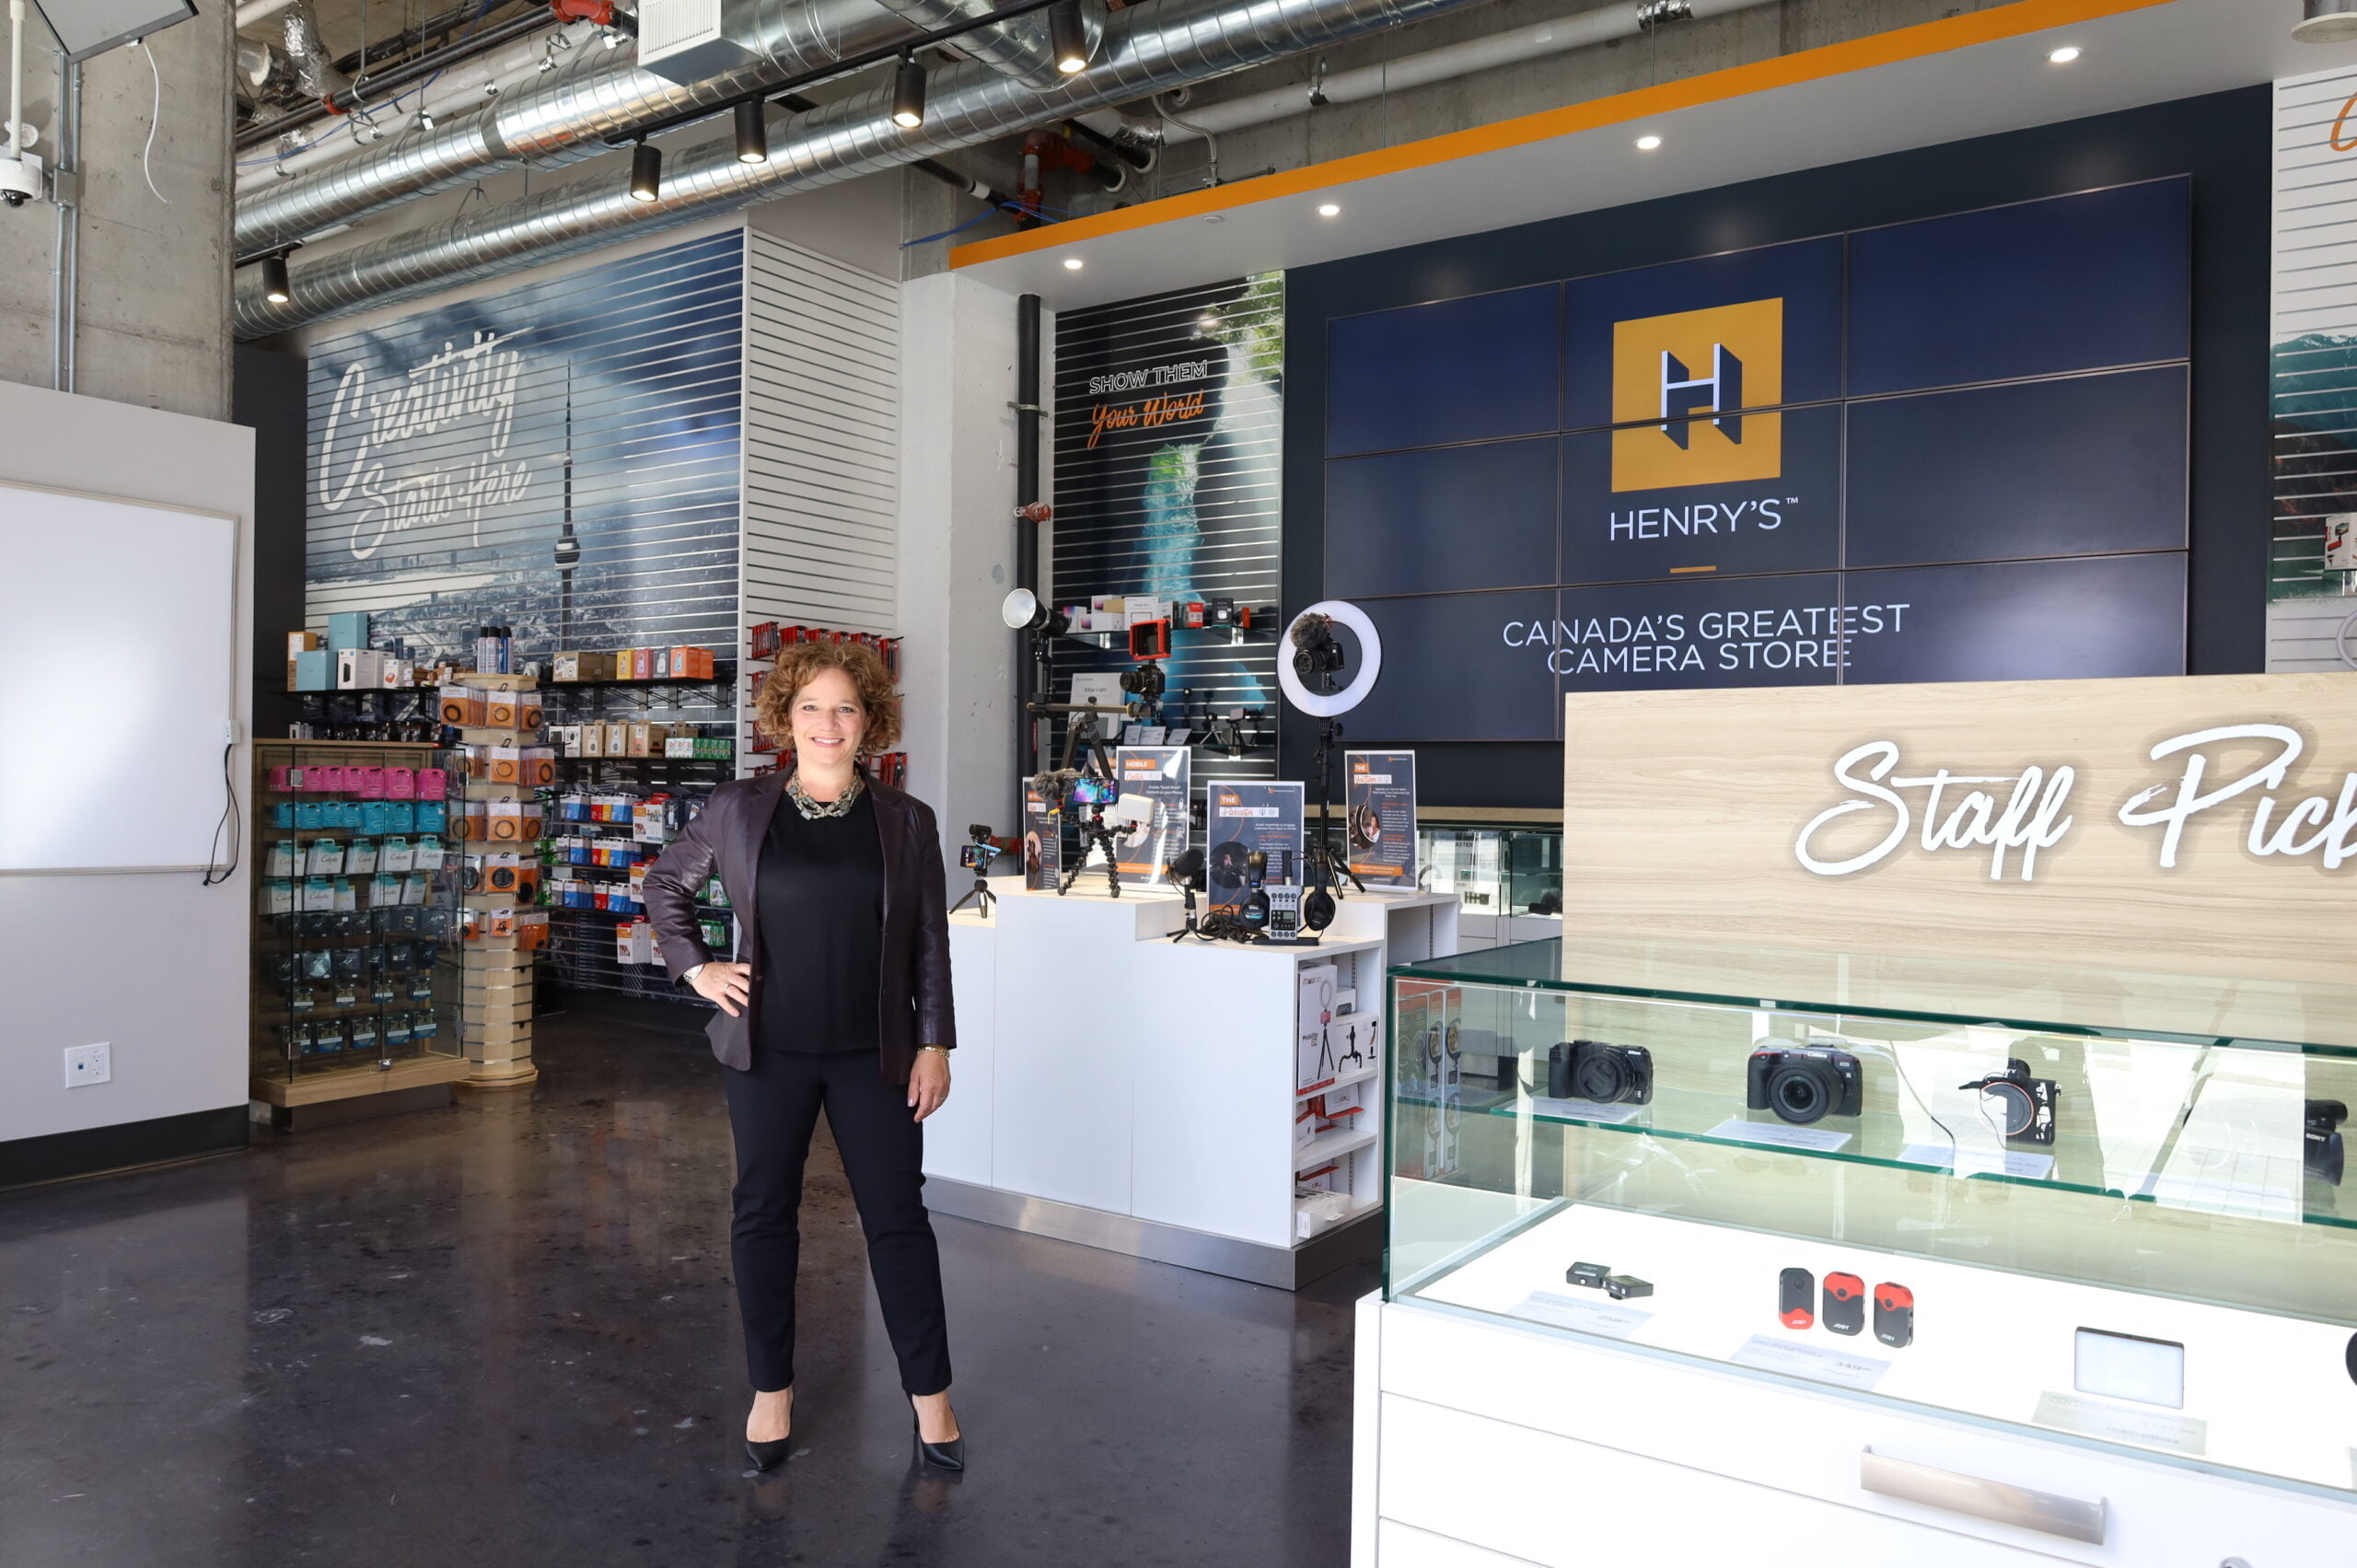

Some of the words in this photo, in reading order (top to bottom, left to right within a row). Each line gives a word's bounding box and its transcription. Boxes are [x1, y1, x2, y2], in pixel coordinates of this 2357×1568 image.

[1089, 369, 1149, 394] SHOW
[1152, 360, 1208, 384] THEM
[320, 326, 534, 511] Creativity
[1086, 402, 1138, 450] Your
[1143, 389, 1207, 427] World
[351, 461, 454, 561] Starts
[457, 452, 532, 548] Here
[1609, 498, 1782, 541] HENRY'S
[1503, 614, 1685, 647] CANADA'S
[1699, 603, 1911, 640] GREATEST
[1547, 645, 1705, 675] CAMERA
[1718, 639, 1852, 669] STORE
[1794, 739, 2075, 881] Staff
[2305, 1132, 2326, 1142] SONY
[1881, 1333, 1896, 1342] JOBY
